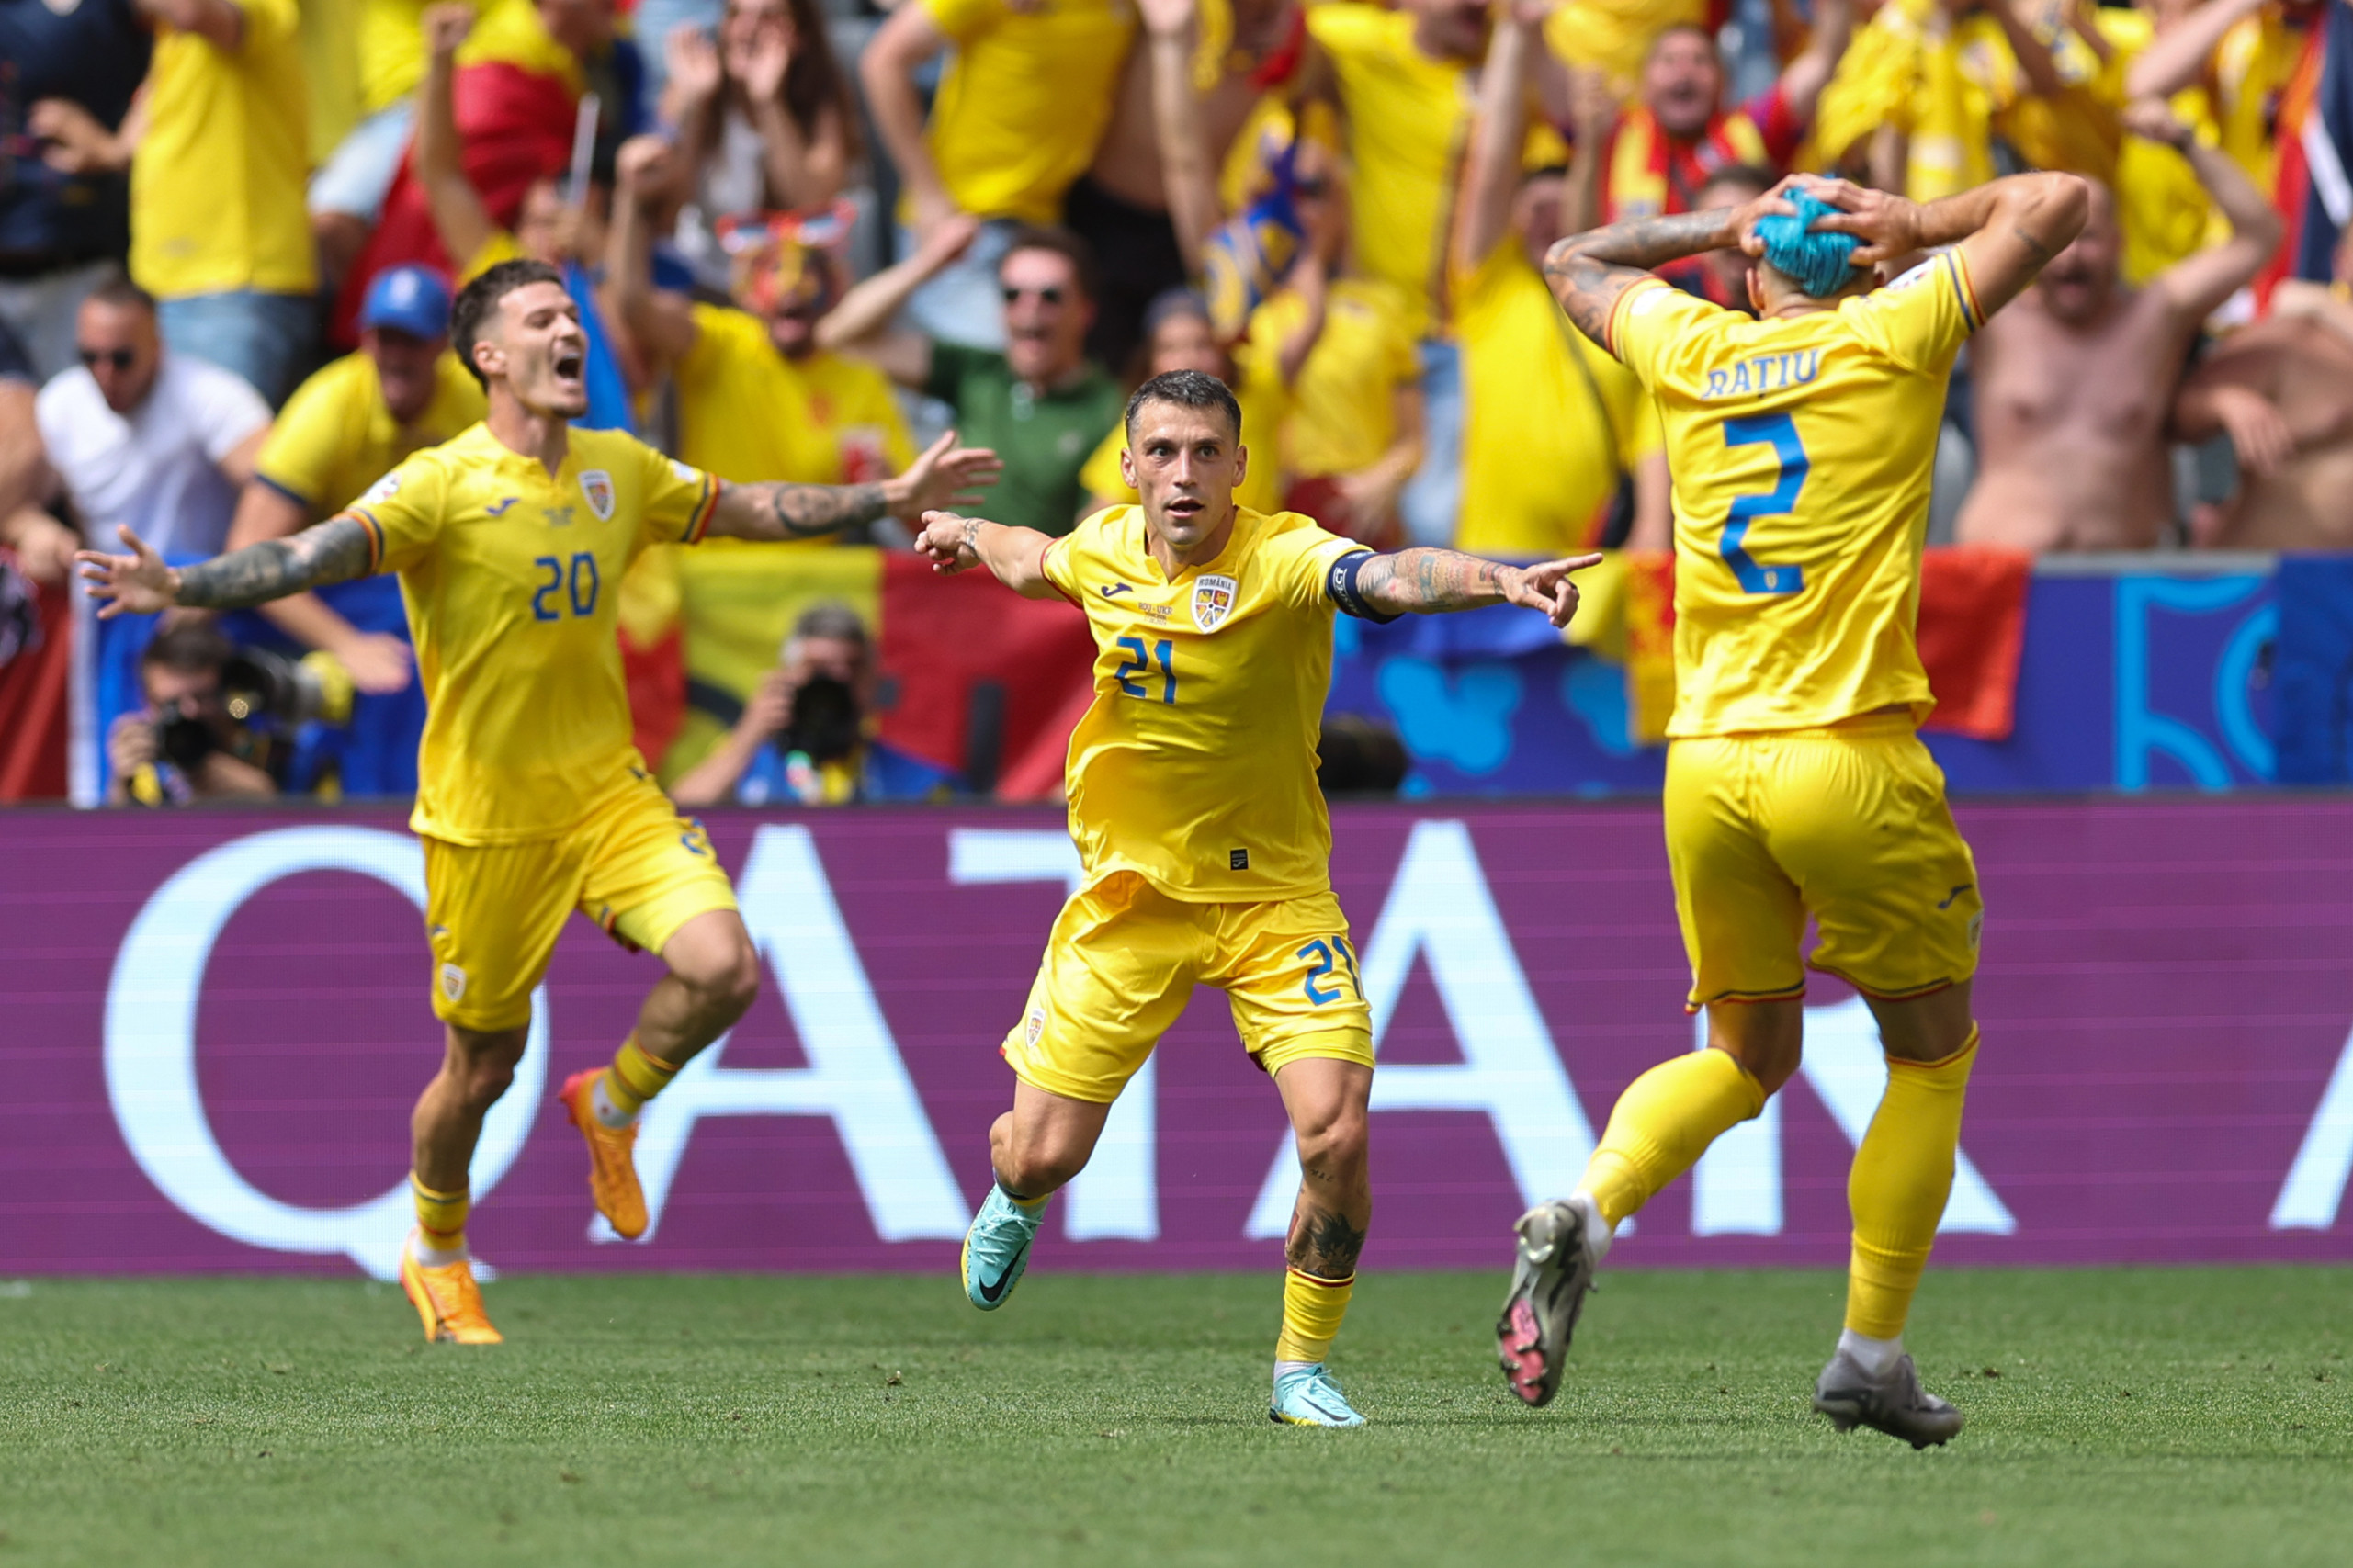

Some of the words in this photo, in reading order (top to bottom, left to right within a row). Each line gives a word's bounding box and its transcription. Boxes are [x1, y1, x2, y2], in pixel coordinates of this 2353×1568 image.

[1720, 412, 1810, 593] 2
[532, 553, 599, 621] 20
[1114, 636, 1176, 705] 21
[1296, 935, 1363, 1006] 21
[103, 822, 2015, 1281] QAA
